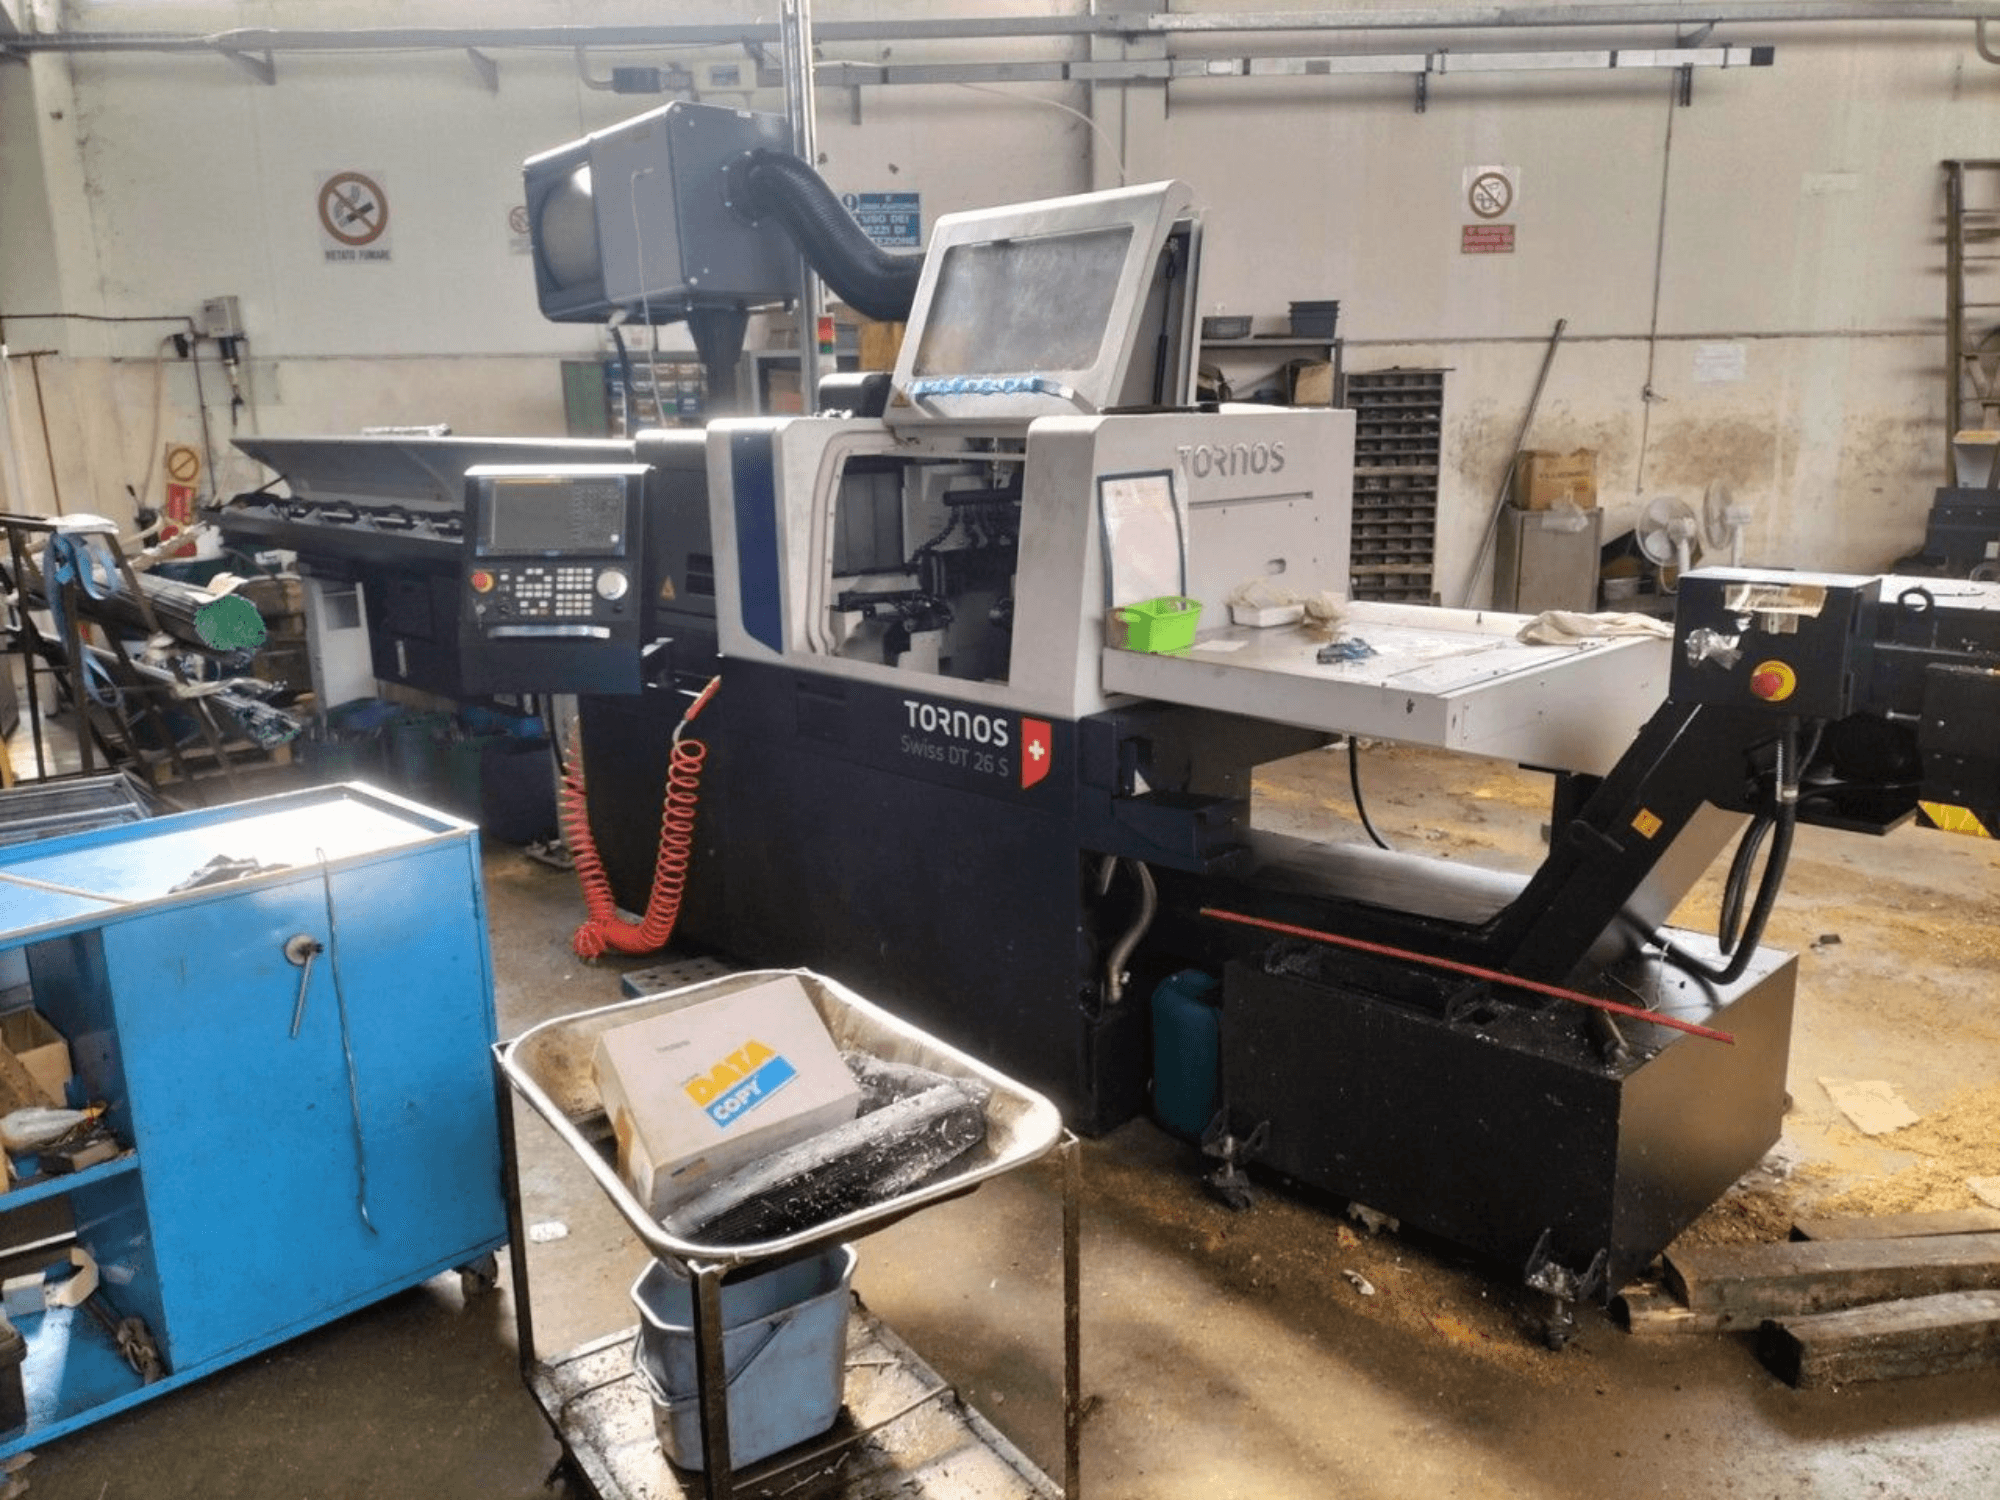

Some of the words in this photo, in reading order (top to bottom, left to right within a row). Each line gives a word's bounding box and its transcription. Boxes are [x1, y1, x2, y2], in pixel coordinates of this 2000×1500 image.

[1175, 441, 1285, 478] TORNOS
[903, 700, 1009, 747] TORNOS
[901, 735, 945, 762] Swiss
[948, 746, 970, 768] DT
[973, 751, 995, 774] 26
[998, 757, 1009, 778] S
[684, 1039, 777, 1108] DATA
[713, 1075, 762, 1120] COPY
